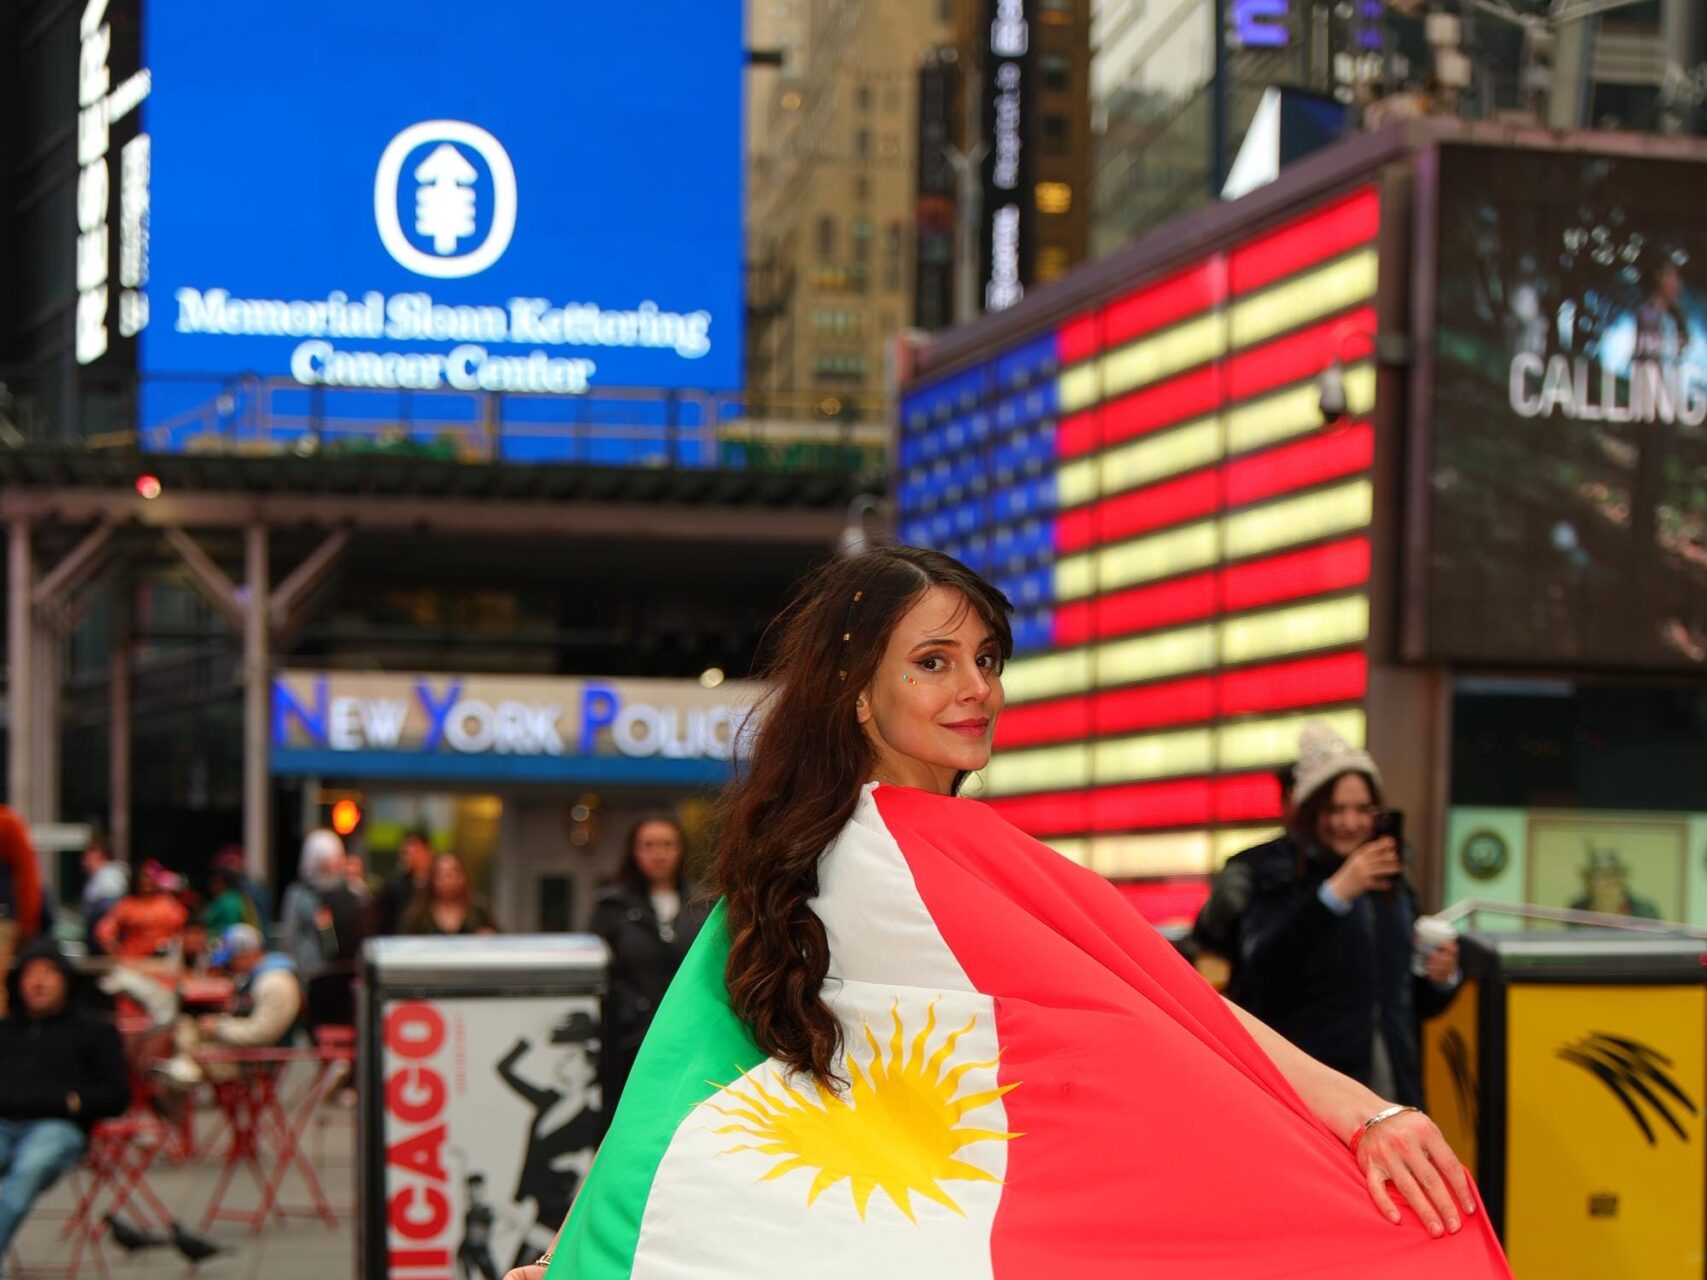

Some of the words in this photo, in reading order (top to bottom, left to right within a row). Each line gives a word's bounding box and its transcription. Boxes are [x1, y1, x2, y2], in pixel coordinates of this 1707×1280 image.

[175, 286, 384, 338] Memorial
[385, 291, 507, 342] Sloan
[506, 297, 712, 359] Kettering
[291, 339, 446, 390] Cancer
[446, 343, 597, 395] Center
[1509, 352, 1707, 426] CALLING
